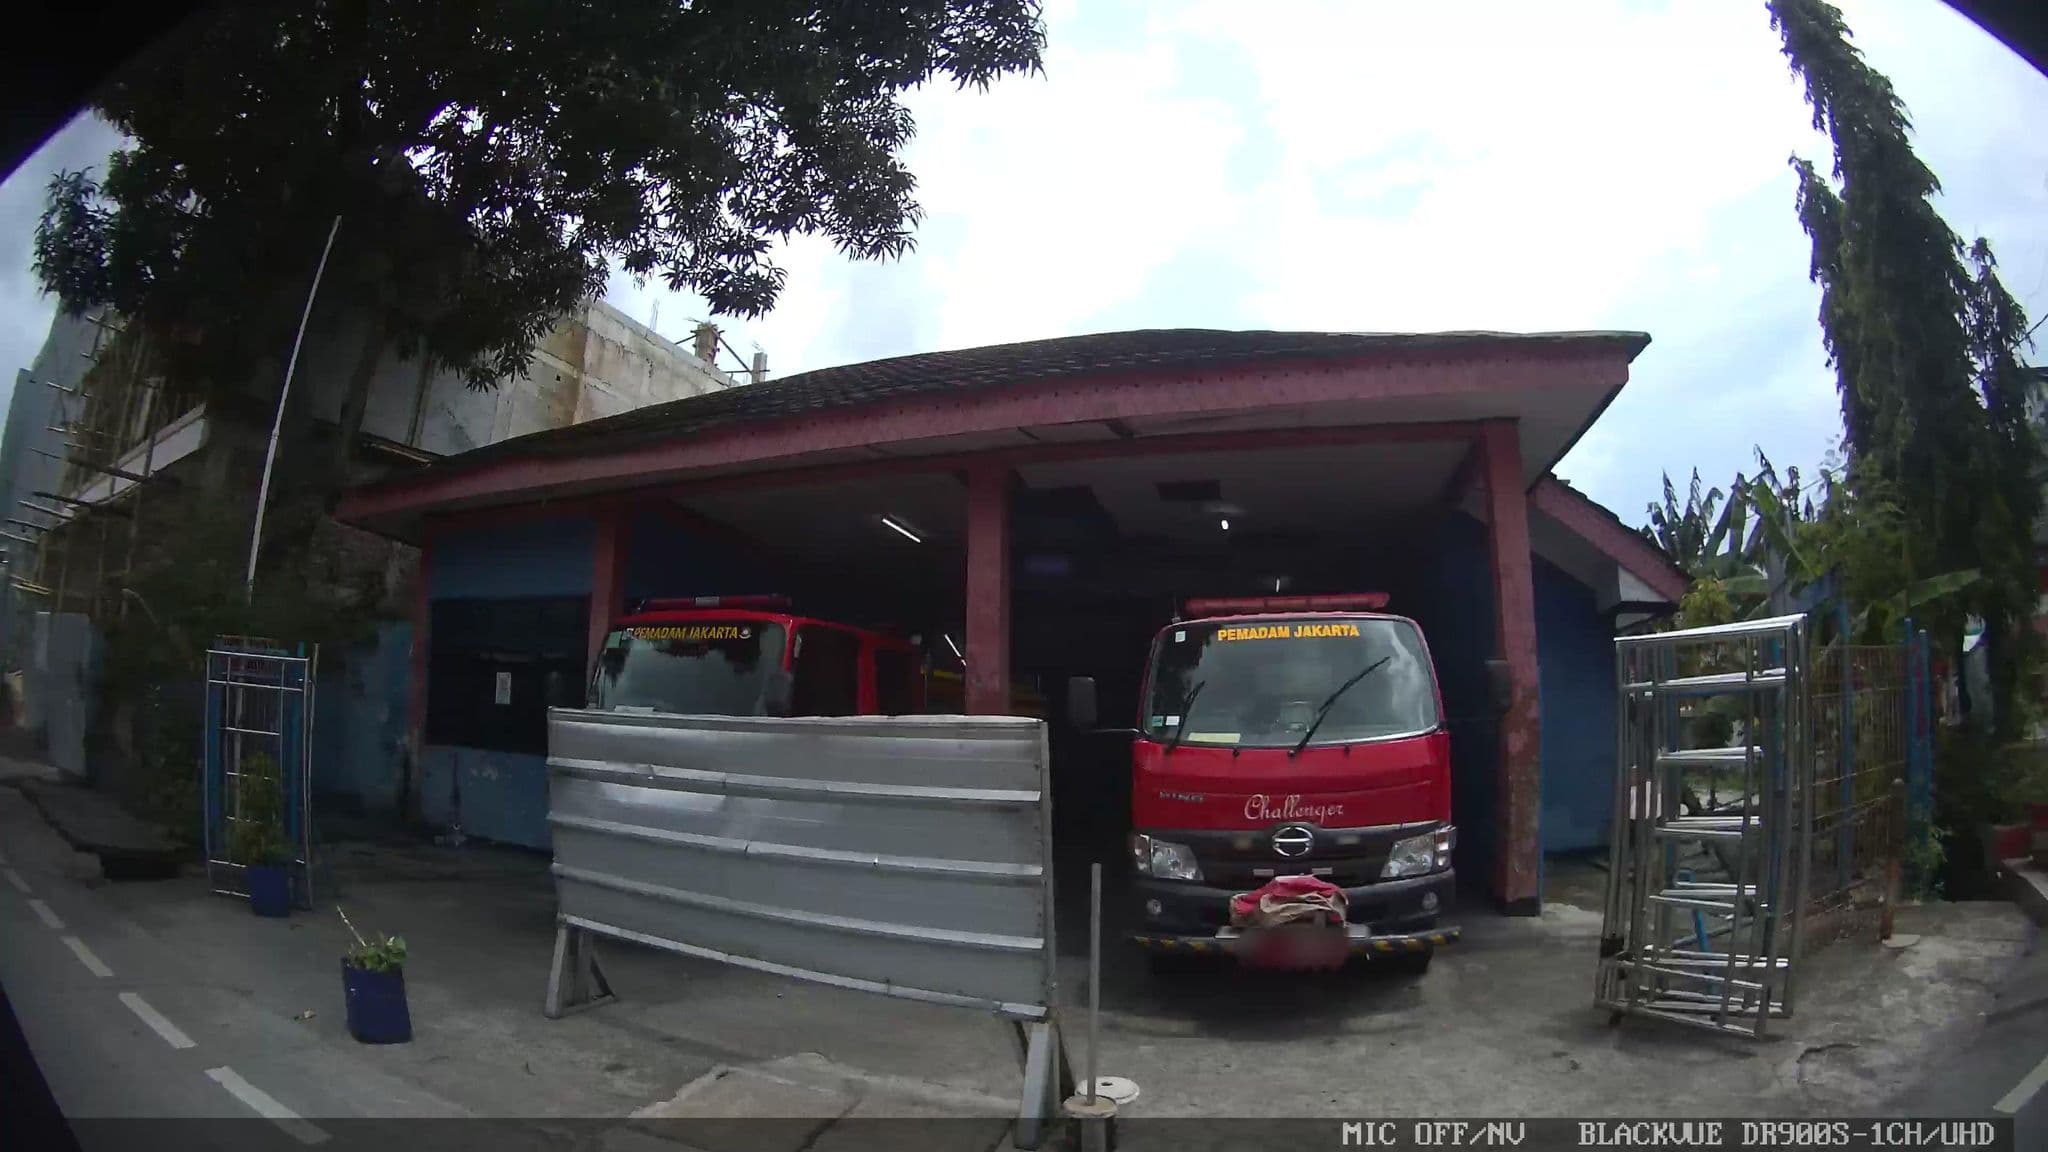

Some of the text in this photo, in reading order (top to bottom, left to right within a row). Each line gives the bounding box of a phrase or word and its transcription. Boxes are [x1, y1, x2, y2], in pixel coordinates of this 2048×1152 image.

[634, 625, 738, 640] PEMADAM JAKARTA
[1217, 624, 1360, 641] PEMADAM JAKARTA
[1243, 793, 1344, 824] Challenger
